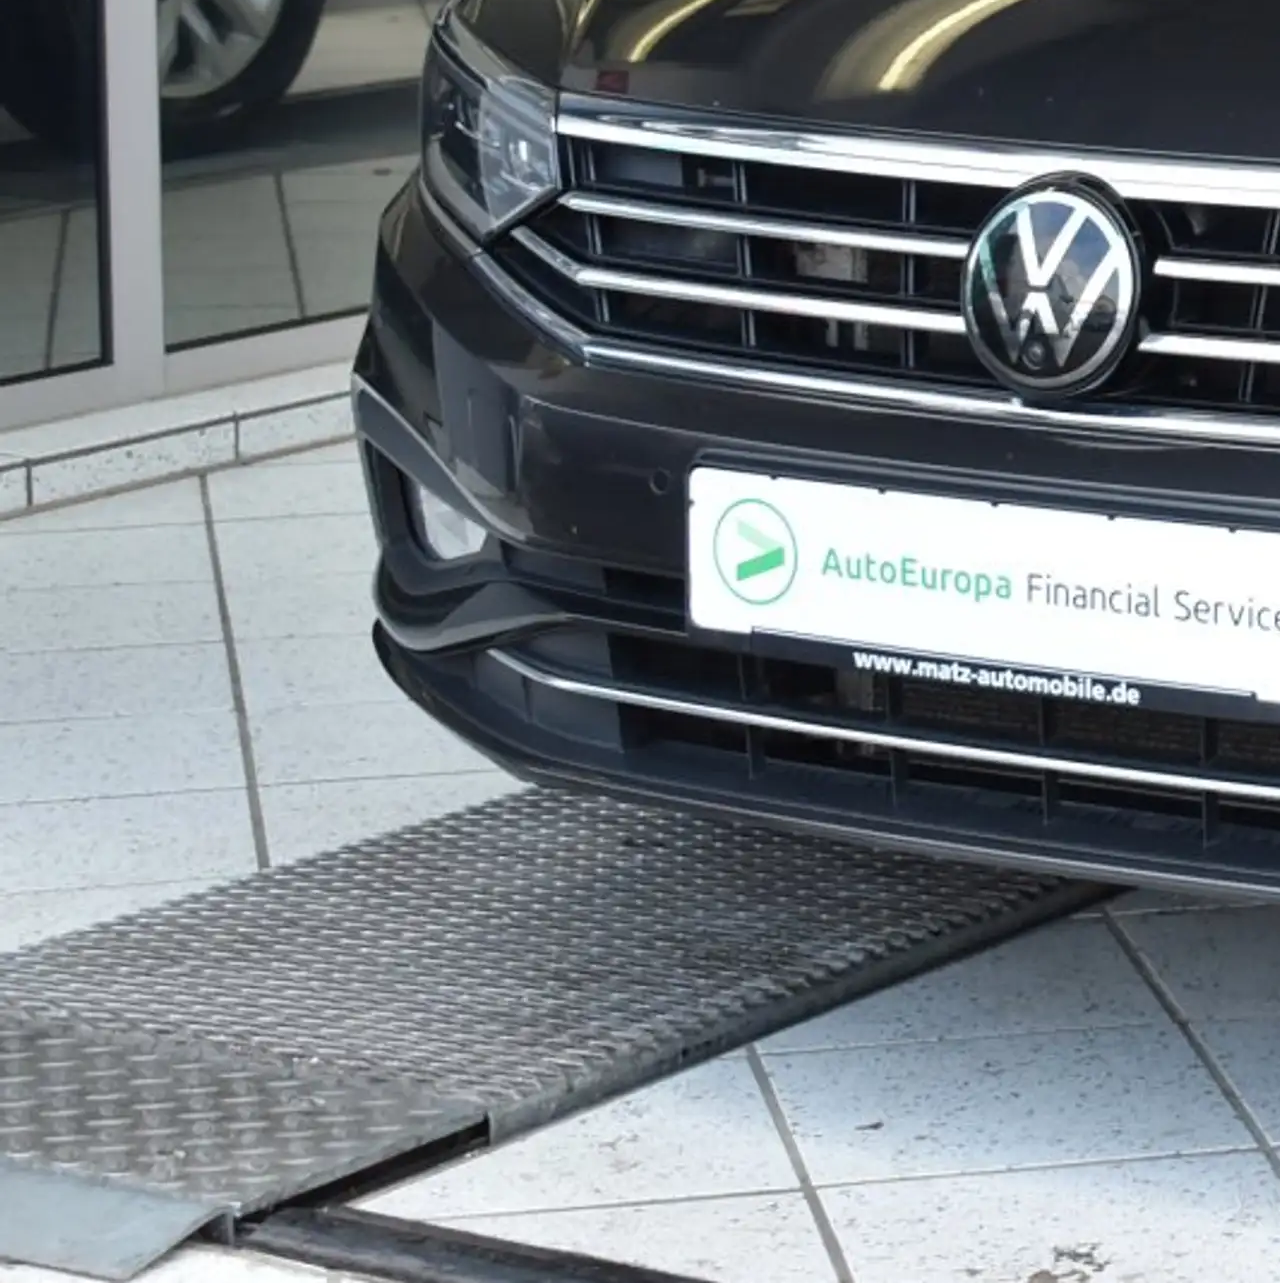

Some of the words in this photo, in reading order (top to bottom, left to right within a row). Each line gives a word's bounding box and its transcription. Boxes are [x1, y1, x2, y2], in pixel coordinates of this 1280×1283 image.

[974, 192, 1126, 376] VW
[821, 547, 1013, 602] AutoEuropa
[1026, 573, 1160, 618] Financial
[853, 651, 1141, 705] www.matz-automobile.de
